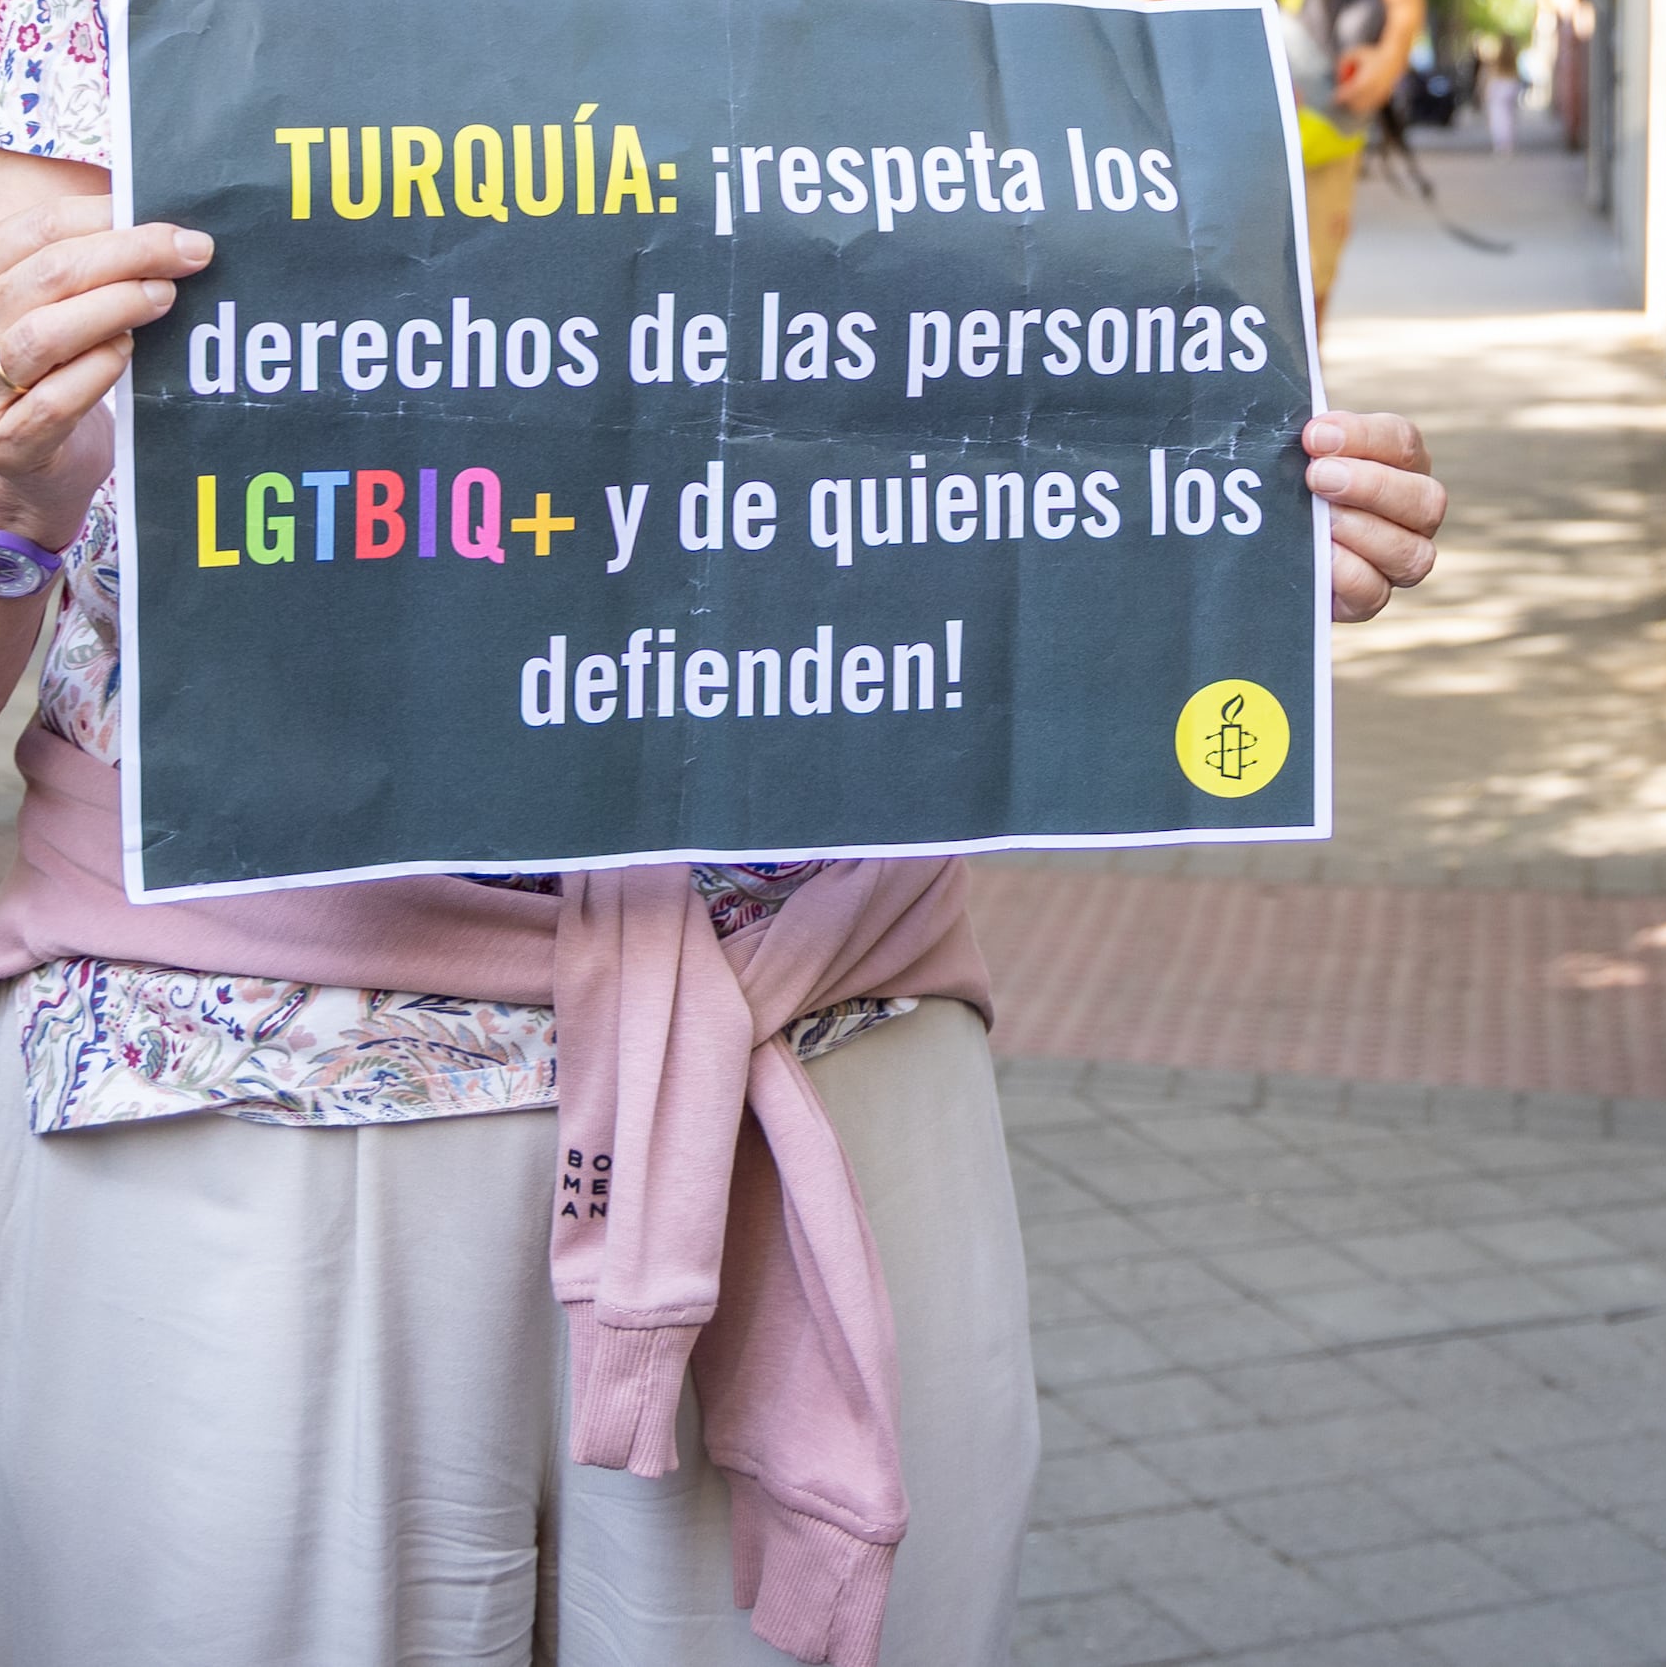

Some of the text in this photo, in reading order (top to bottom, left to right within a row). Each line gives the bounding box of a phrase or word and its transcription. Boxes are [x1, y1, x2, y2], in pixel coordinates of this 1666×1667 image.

[275, 103, 1179, 236] TURQUÍA: ¡respeta los
[189, 292, 1267, 397] derechos de las personas
[198, 446, 1262, 573] LGTBIQ+ y de quienes los
[521, 620, 963, 726] defienden!
